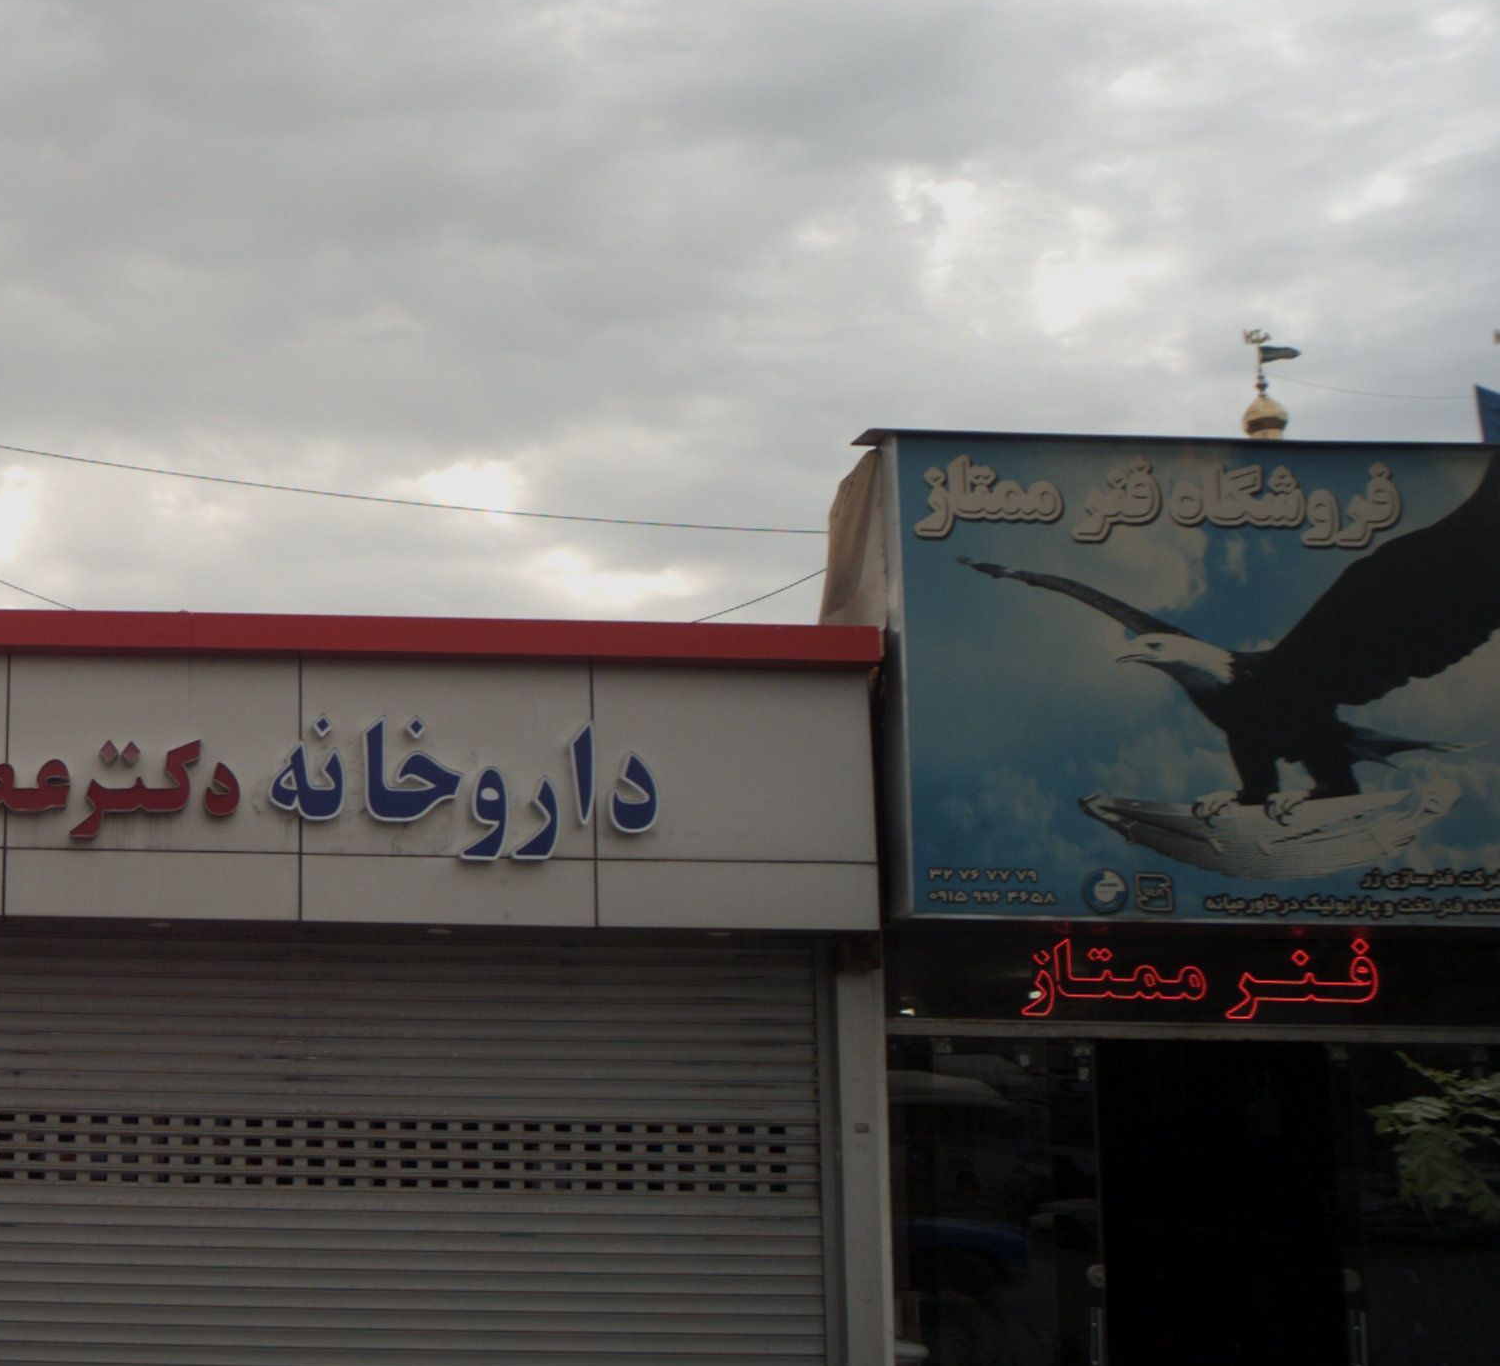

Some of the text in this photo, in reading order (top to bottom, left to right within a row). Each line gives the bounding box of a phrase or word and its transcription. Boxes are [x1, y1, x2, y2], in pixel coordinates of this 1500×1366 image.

[915, 453, 1400, 549] فروشگاه فنر ممتاز
[70, 739, 241, 839] دکتر
[267, 713, 659, 861] داروخانه
[1021, 937, 1380, 1020] فنر ممتاز
